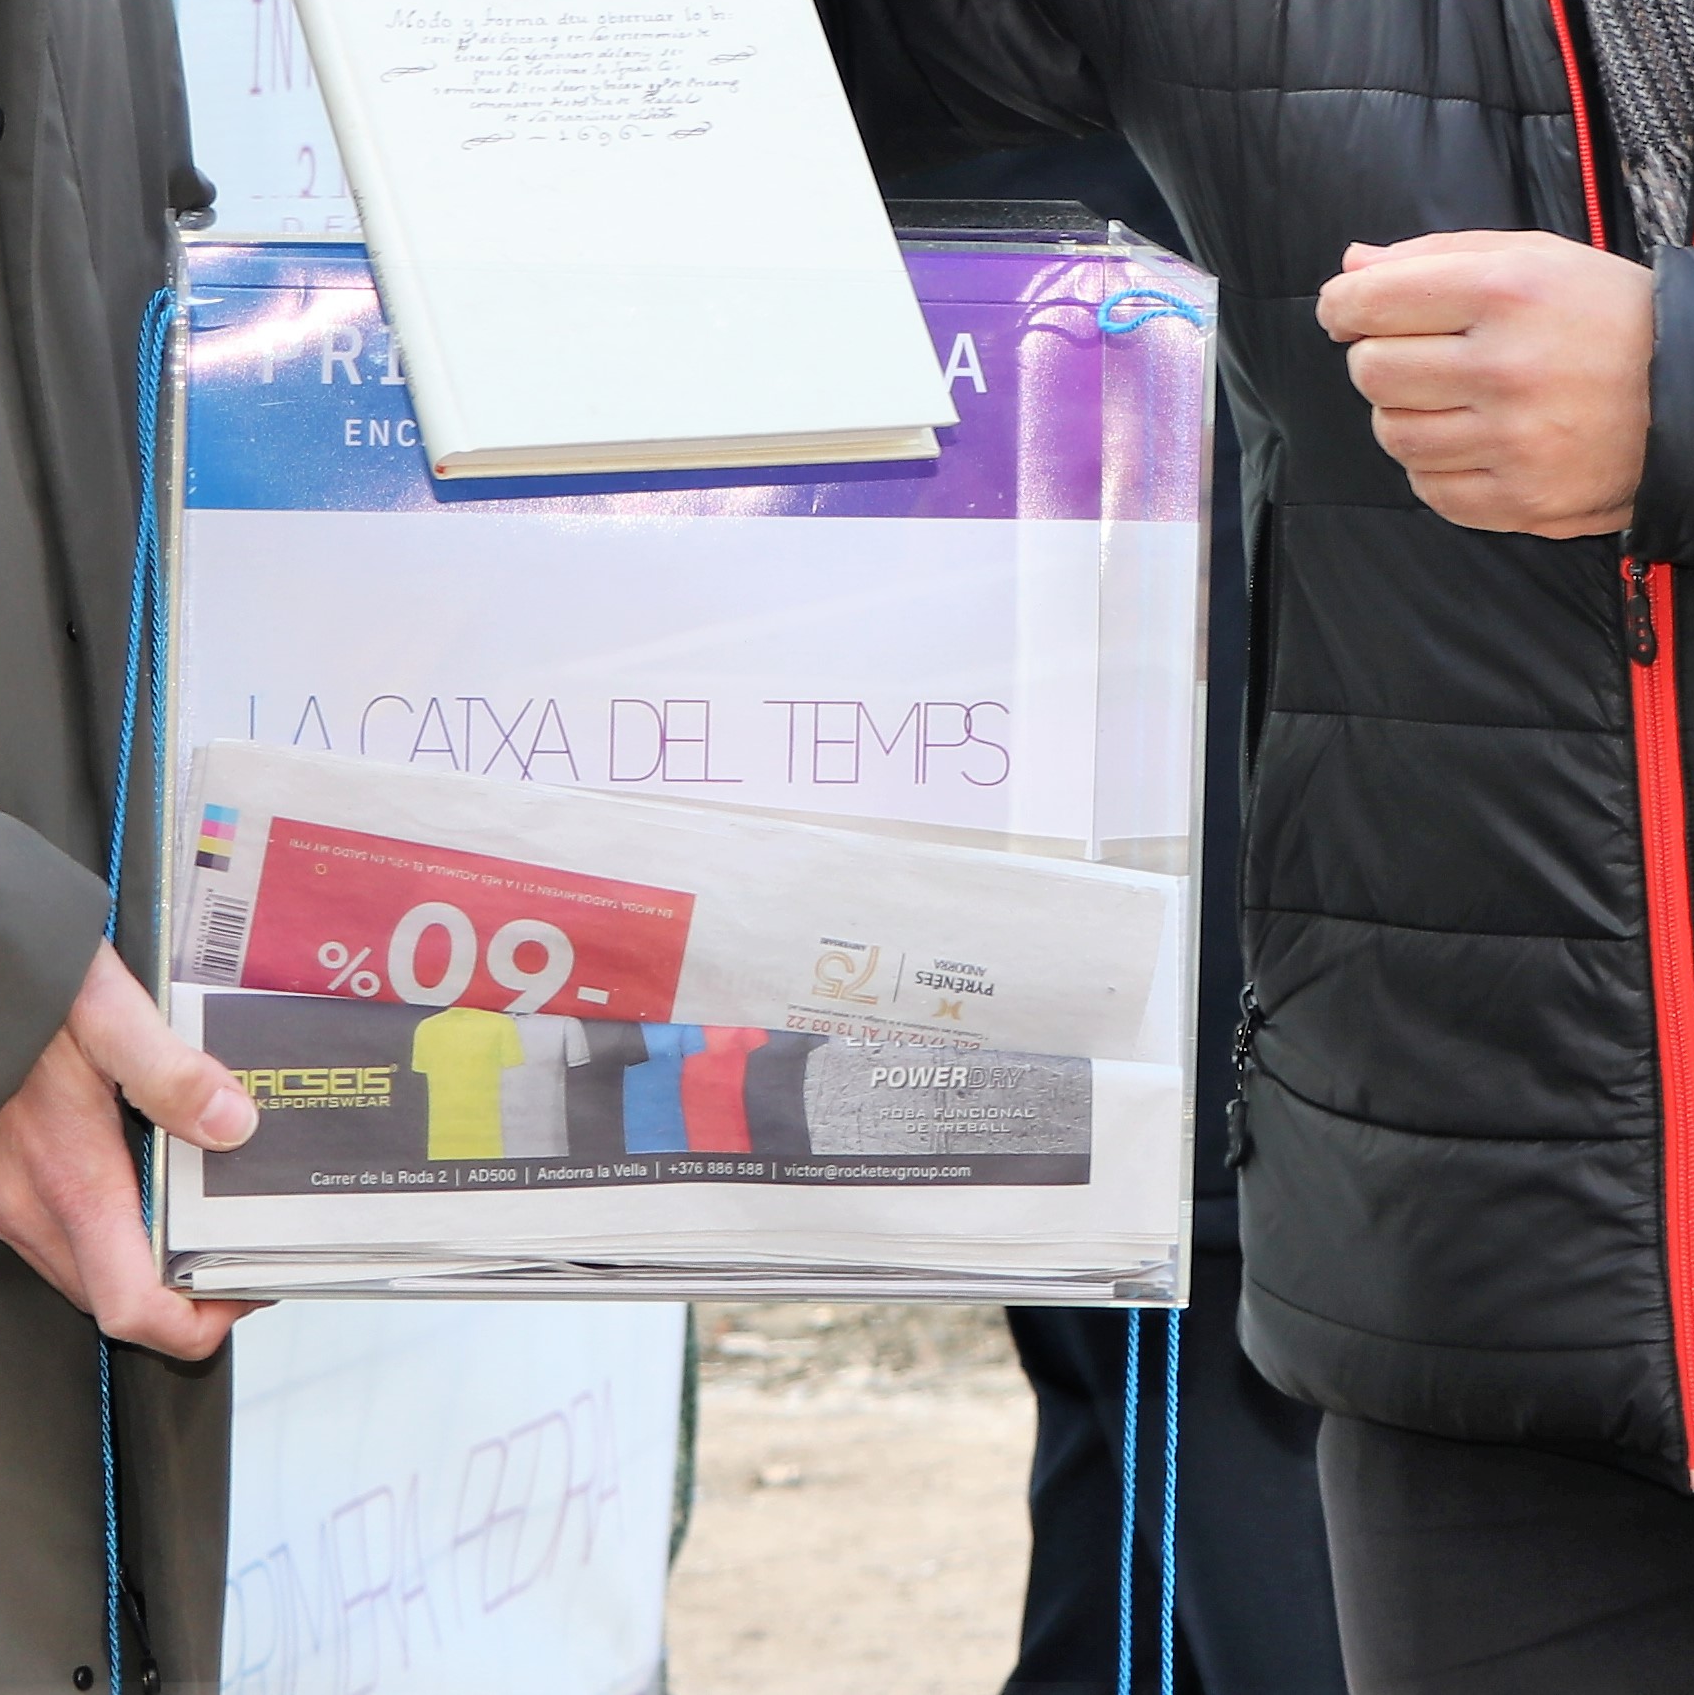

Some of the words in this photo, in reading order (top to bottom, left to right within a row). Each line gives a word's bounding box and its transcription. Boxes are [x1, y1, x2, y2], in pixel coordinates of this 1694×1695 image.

[609, 699, 744, 784] DEL
[763, 700, 1011, 787] TEMPS
[811, 945, 881, 1005] 75
[933, 958, 988, 977] ANDORRA
[914, 969, 995, 997] PYRÉNÉES
[933, 1107, 1036, 1120] FUNCIONAL
[905, 1122, 930, 1134] DE
[933, 1122, 1012, 1134] TREBALL
[310, 1171, 356, 1187] Carrer
[359, 1170, 378, 1185] de
[381, 1170, 394, 1185] la
[397, 1169, 434, 1185] Roda
[437, 1169, 448, 1184] 2
[467, 1168, 517, 1184] AD500
[536, 1164, 595, 1182] Andorra
[598, 1163, 610, 1179] la
[613, 1162, 648, 1178] Vella
[668, 1162, 704, 1177] +376
